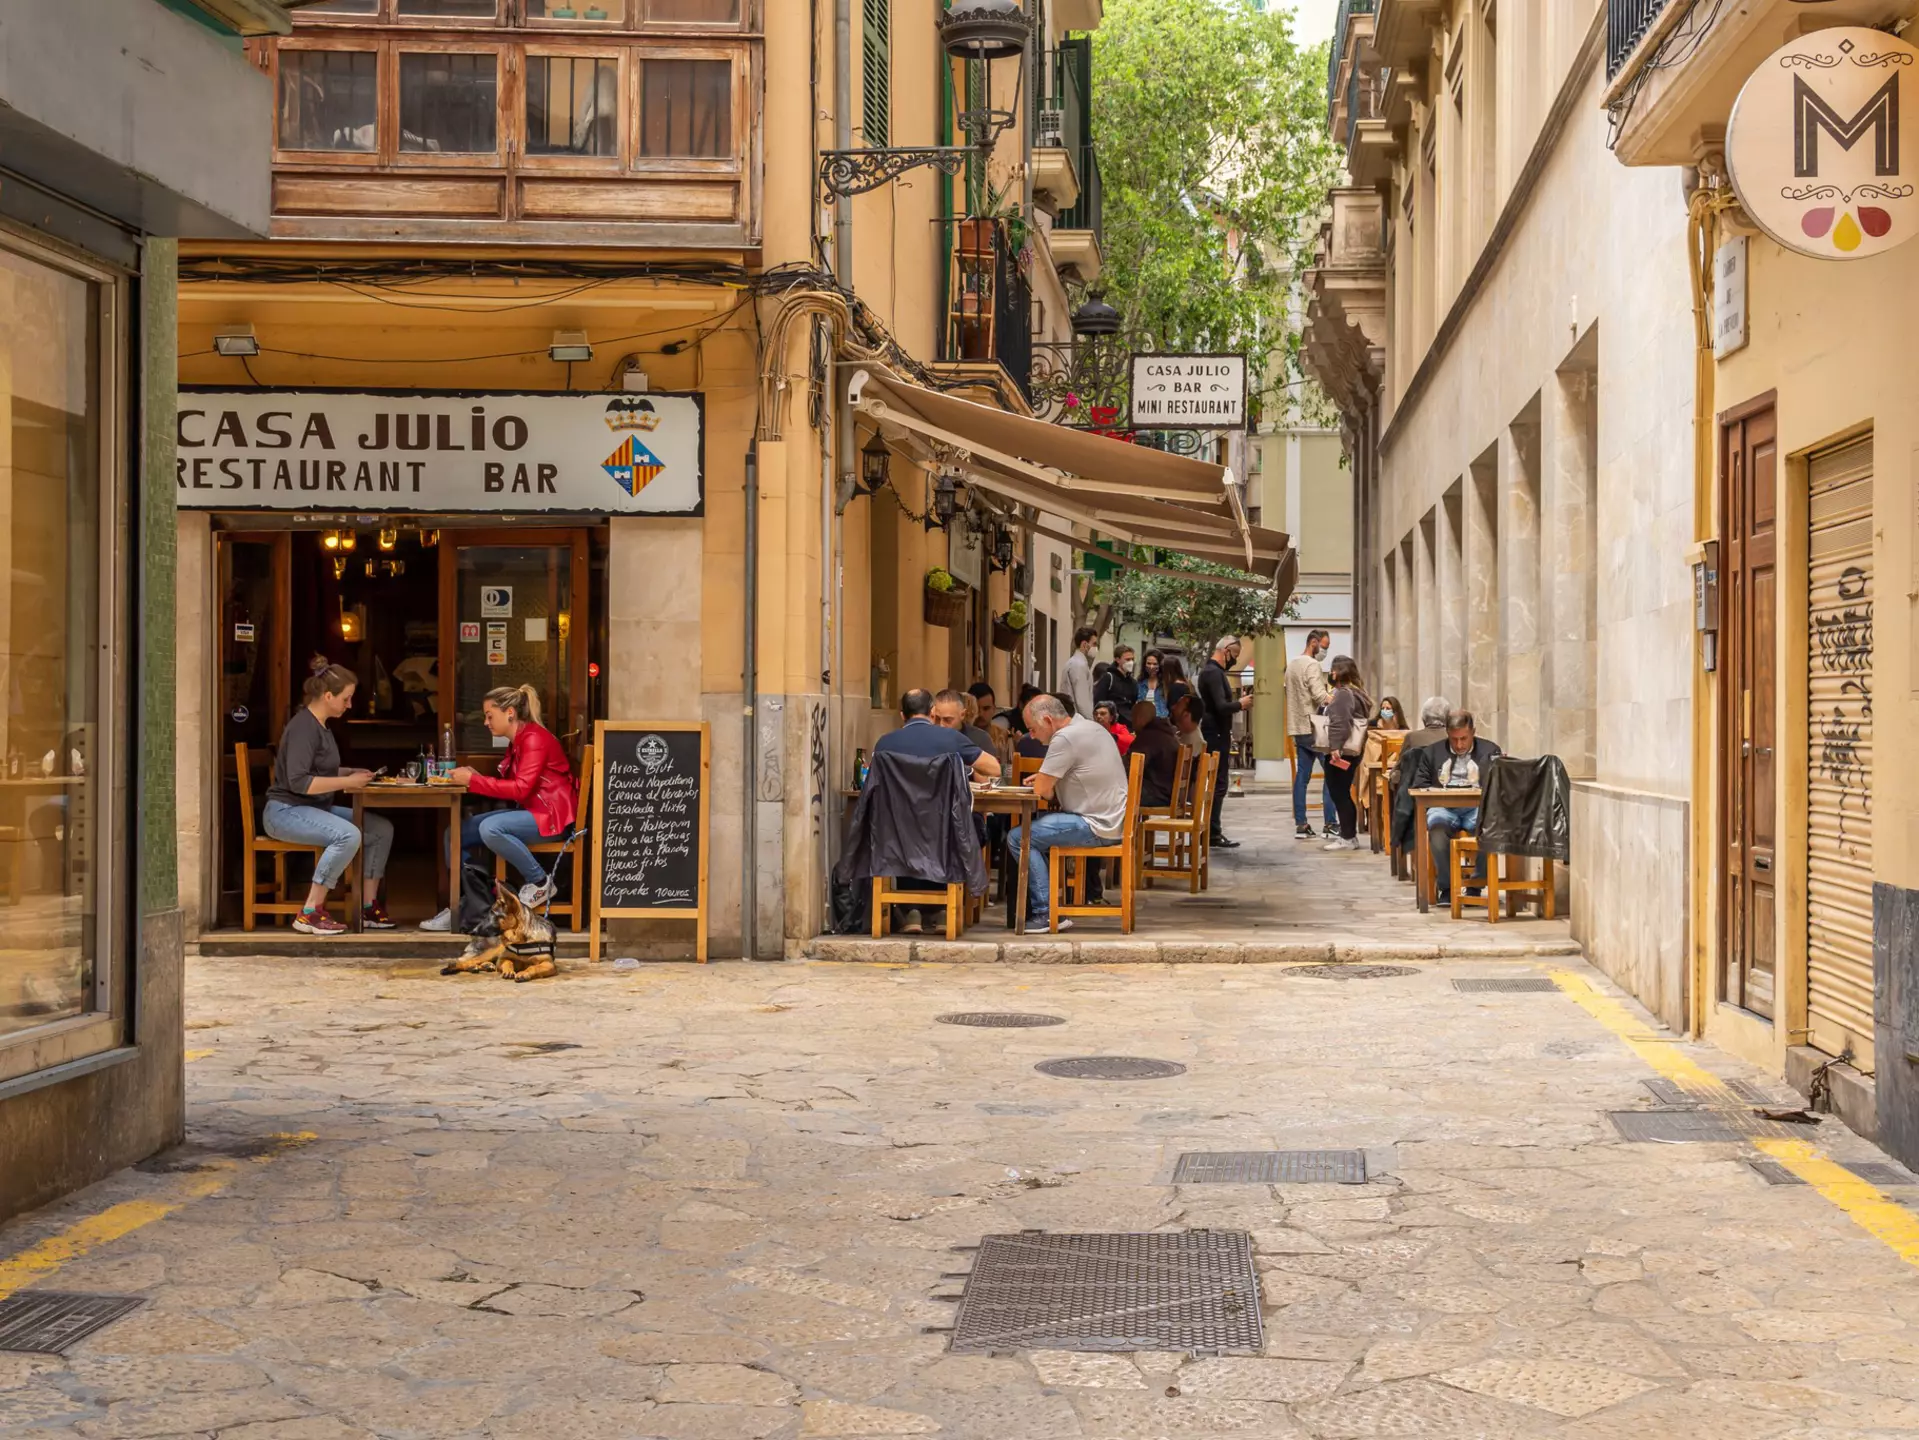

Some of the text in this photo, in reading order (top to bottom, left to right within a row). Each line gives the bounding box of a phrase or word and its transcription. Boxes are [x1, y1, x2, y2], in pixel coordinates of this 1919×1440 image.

[1793, 69, 1900, 178] M
[1146, 365, 1230, 376] CASA JULIO
[1174, 382, 1202, 393] BAR
[1138, 400, 1237, 414] MINI RESTAURANT
[177, 409, 336, 450] CASA
[484, 462, 558, 495] BAR
[609, 760, 641, 774] Arroz
[608, 790, 643, 802] Crema
[646, 789, 660, 801] de
[608, 799, 687, 815] Ensalada Mixta
[606, 818, 634, 833] Frito
[604, 833, 627, 848] Pollo
[631, 837, 638, 845] a
[640, 834, 654, 844] las
[632, 849, 641, 857] a
[642, 846, 654, 856] la
[605, 856, 668, 873] Huevos fritos
